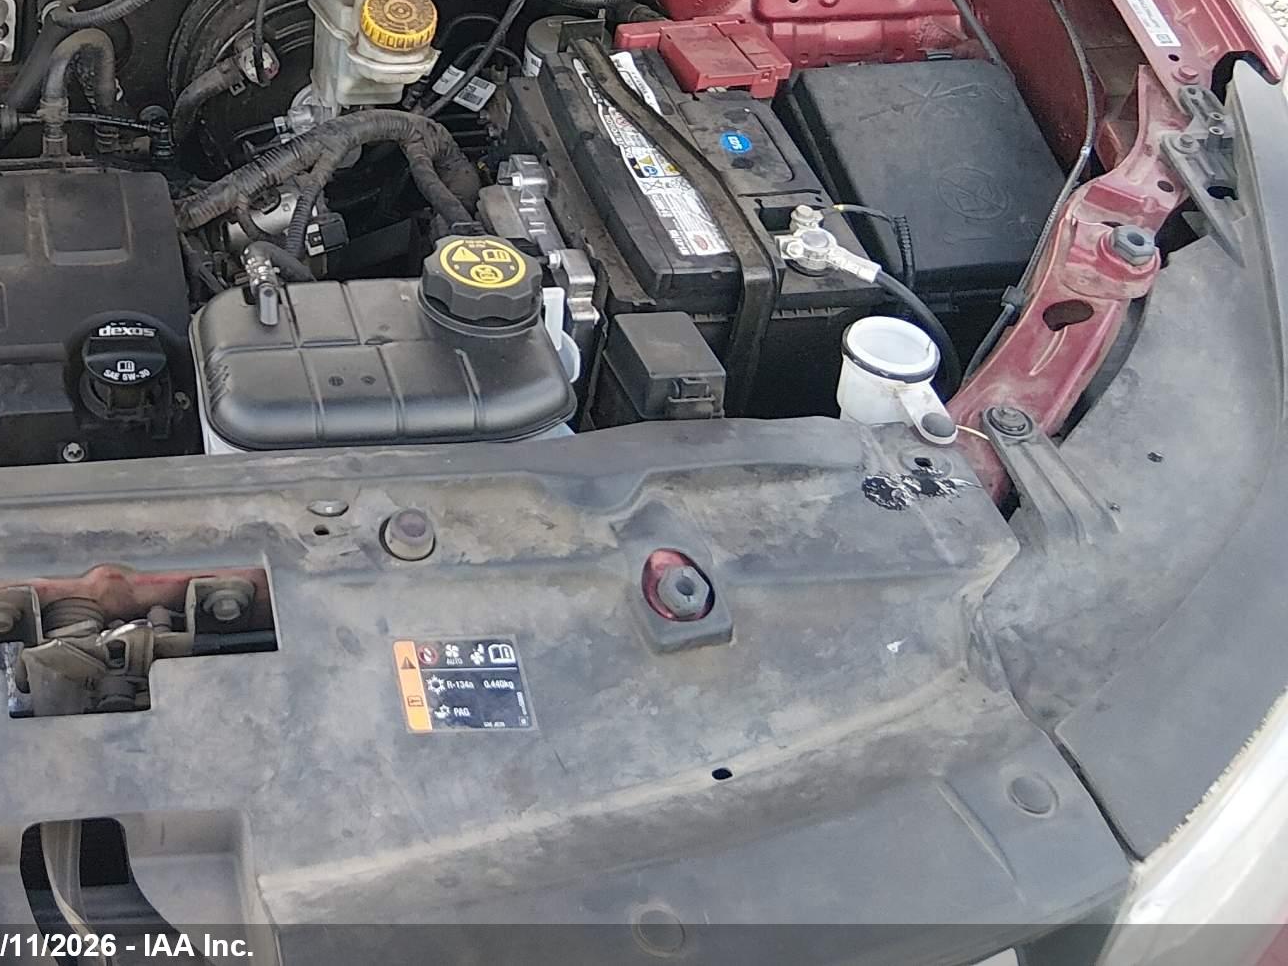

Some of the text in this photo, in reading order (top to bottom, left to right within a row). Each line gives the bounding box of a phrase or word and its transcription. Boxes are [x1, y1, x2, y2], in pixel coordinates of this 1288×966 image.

[99, 325, 156, 337] dexos
[103, 369, 150, 381] SAE 5W-30
[446, 680, 474, 689] R-134a
